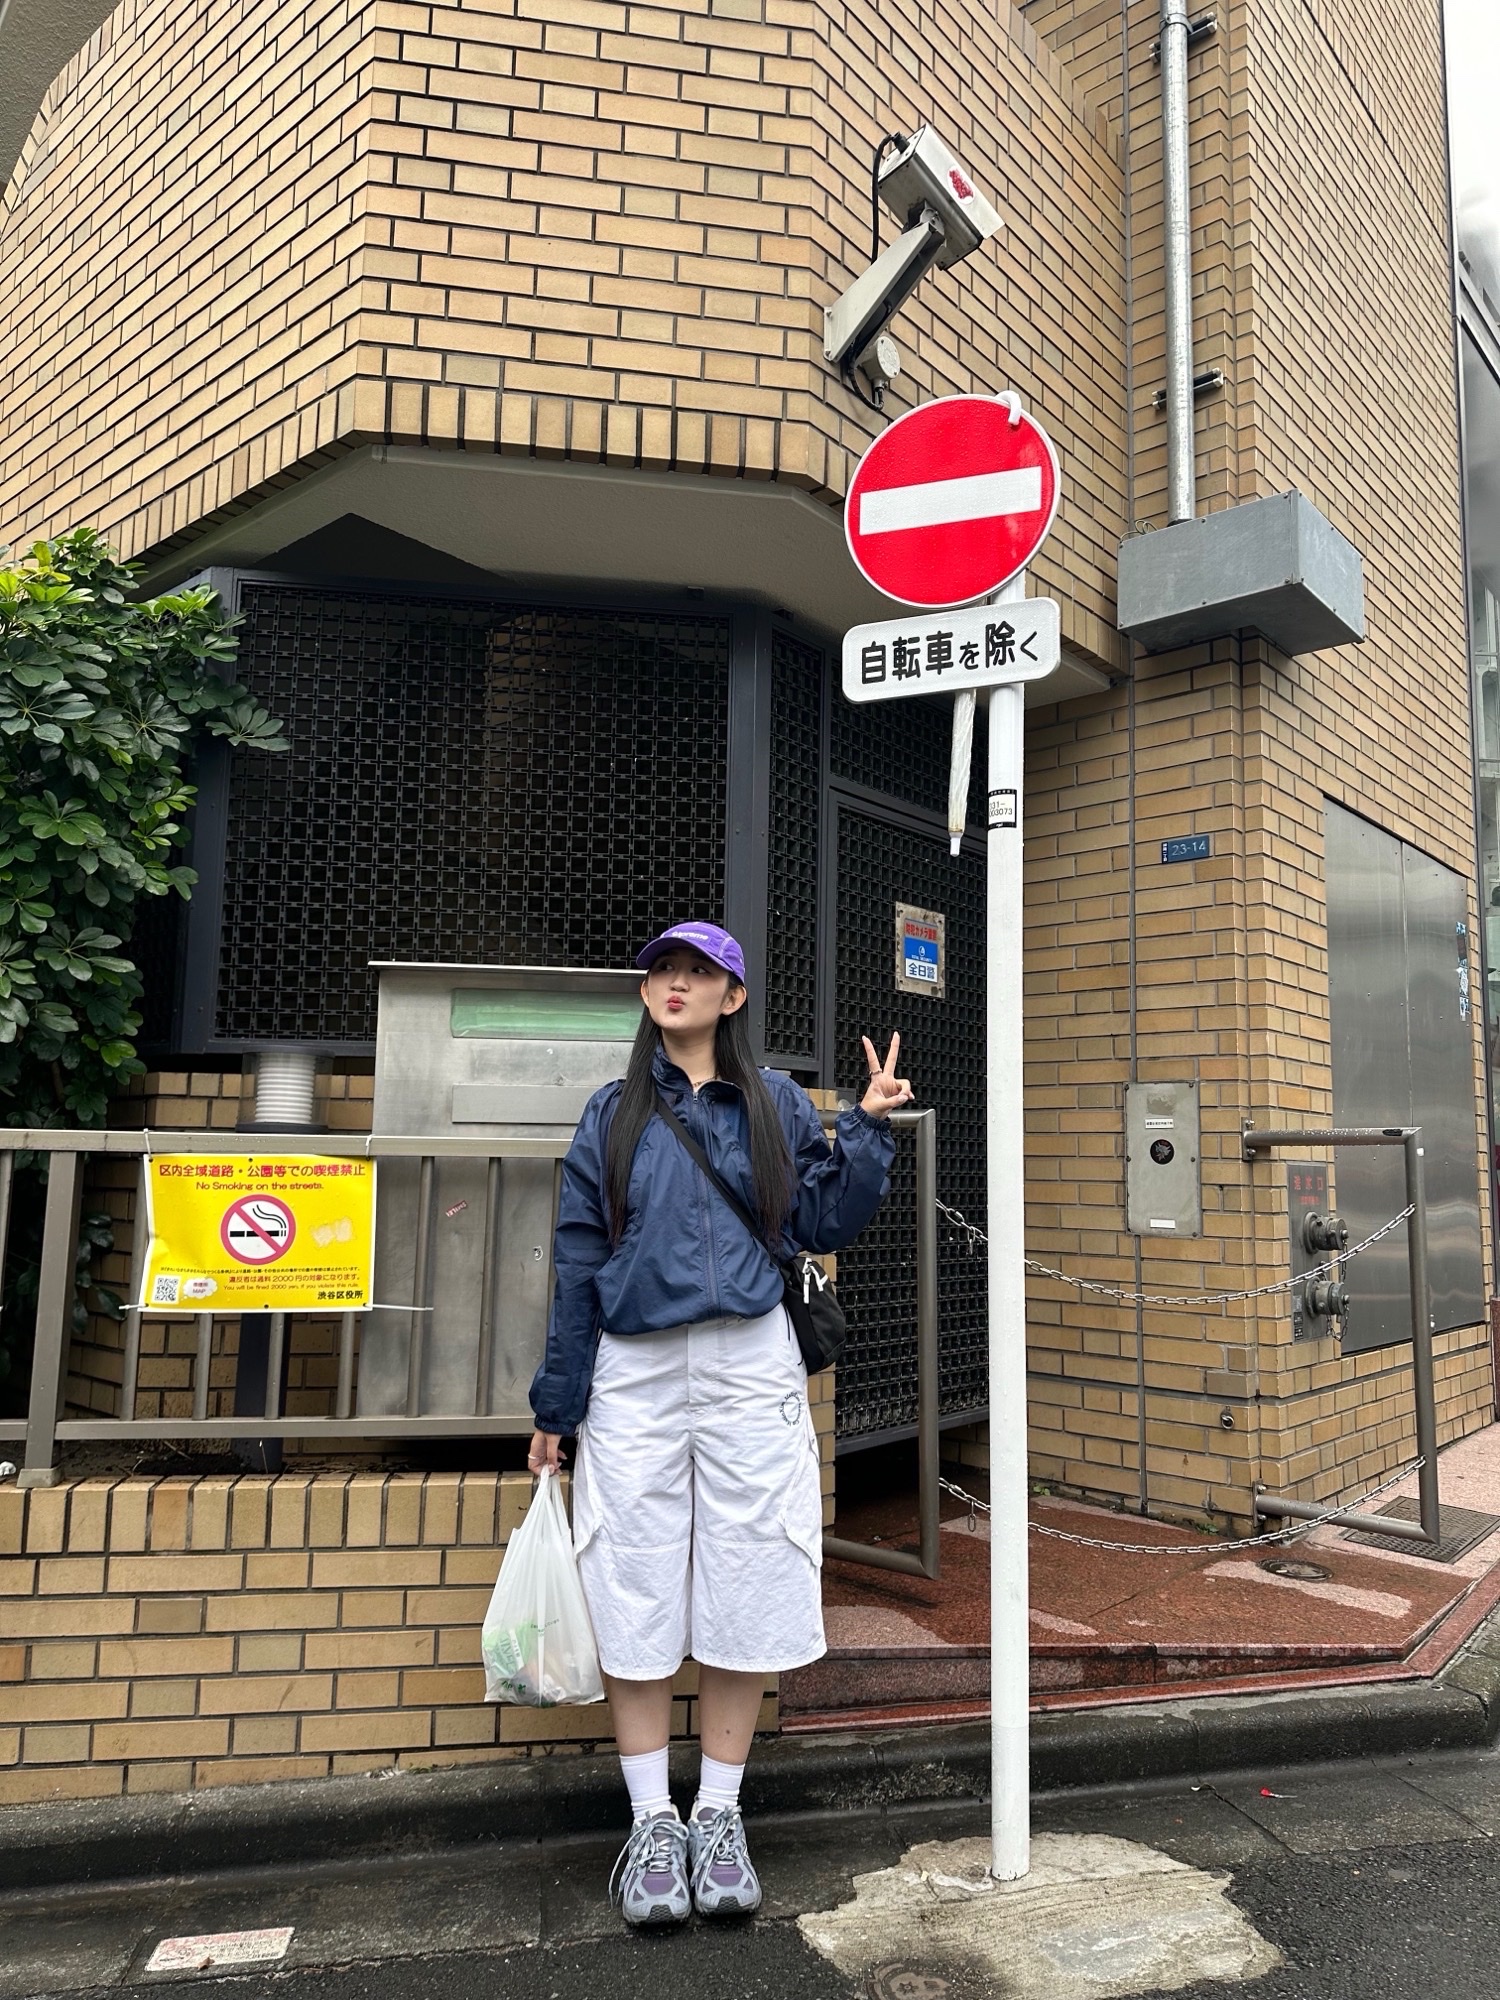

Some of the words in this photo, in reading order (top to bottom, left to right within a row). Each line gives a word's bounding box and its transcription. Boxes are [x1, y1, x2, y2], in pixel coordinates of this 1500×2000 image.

[861, 621, 1038, 684] 自転車を除く
[1172, 840, 1206, 856] 23-14
[159, 1164, 366, 1178] 区内全域道路・公園等での喫煙禁止
[196, 1182, 210, 1190] No
[212, 1182, 253, 1191] Smoking
[271, 1182, 287, 1190] the
[289, 1182, 324, 1190] streets.
[317, 1290, 363, 1300] 渋谷区役所
